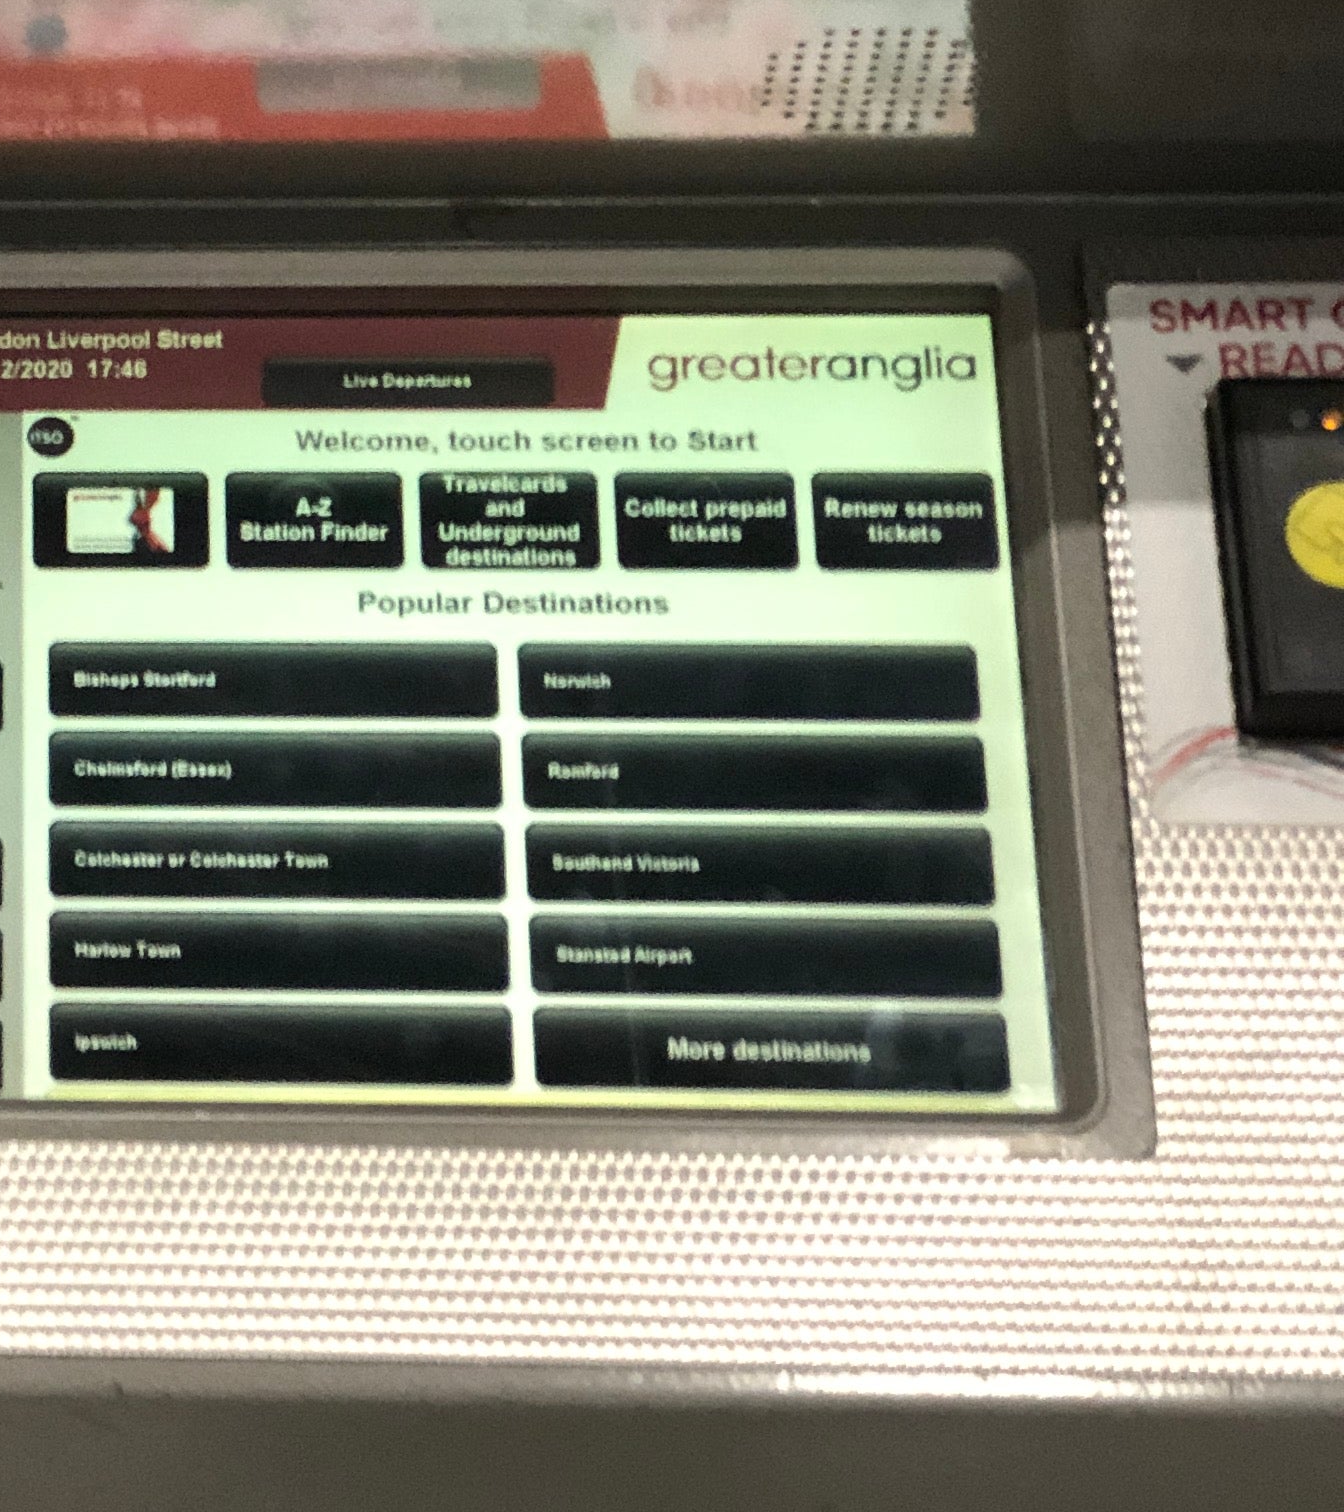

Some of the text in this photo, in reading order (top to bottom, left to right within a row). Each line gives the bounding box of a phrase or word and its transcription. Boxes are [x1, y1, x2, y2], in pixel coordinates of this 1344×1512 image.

[1148, 297, 1315, 333] SMART
[46, 329, 152, 354] Liverpool
[157, 328, 224, 351] Street
[87, 358, 148, 380] 17:46
[647, 344, 978, 393] greateranglia
[1218, 340, 1344, 379] READ
[342, 373, 472, 392] Live Departures
[295, 429, 759, 455] Welcome, touch screen to Start
[442, 473, 569, 495] Travelcards
[295, 497, 333, 519] A-Z
[484, 497, 526, 518] and
[624, 497, 787, 522] Collect prepaid
[824, 497, 984, 520] Renew season
[239, 521, 389, 543] Station Finder
[437, 523, 581, 548] Underground
[668, 523, 743, 544] tickets
[868, 523, 943, 544] tickets
[444, 547, 577, 568] destinations
[357, 589, 670, 618] Popular Destinations
[73, 759, 167, 778] Chelmsford
[548, 761, 620, 780] Romford
[73, 849, 165, 869] Colchester
[189, 850, 280, 869] Colchester
[284, 850, 330, 869] Town
[74, 941, 182, 959] Harlow Town
[634, 945, 694, 968] Airport
[74, 1033, 139, 1053] Ipswich
[667, 1035, 872, 1064] More destinations
